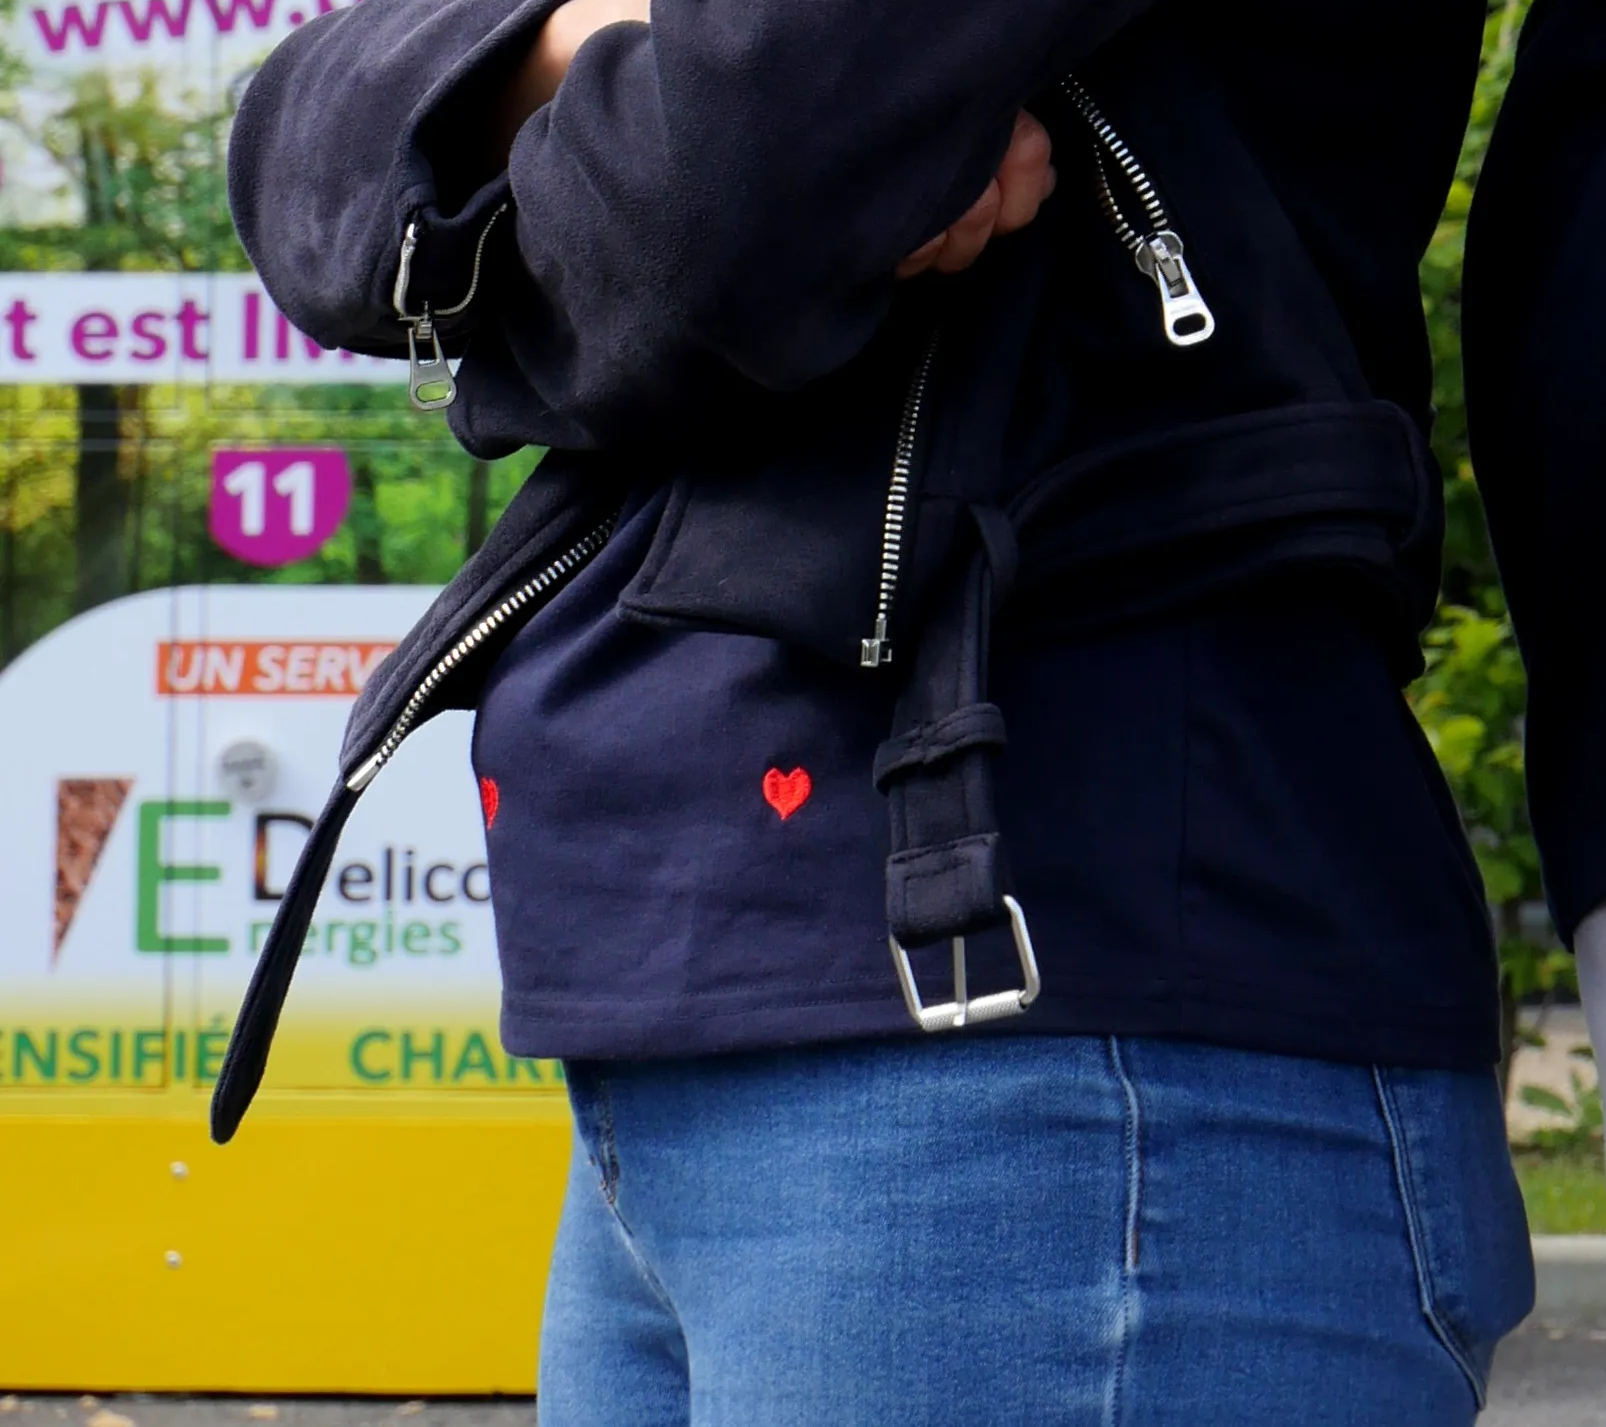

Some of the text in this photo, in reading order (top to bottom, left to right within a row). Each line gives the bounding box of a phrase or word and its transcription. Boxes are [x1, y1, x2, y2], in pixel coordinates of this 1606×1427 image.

[71, 299, 209, 361] est
[222, 461, 316, 537] 11
[165, 644, 244, 692] UN
[0, 1013, 231, 1080] NSIFIÉ
